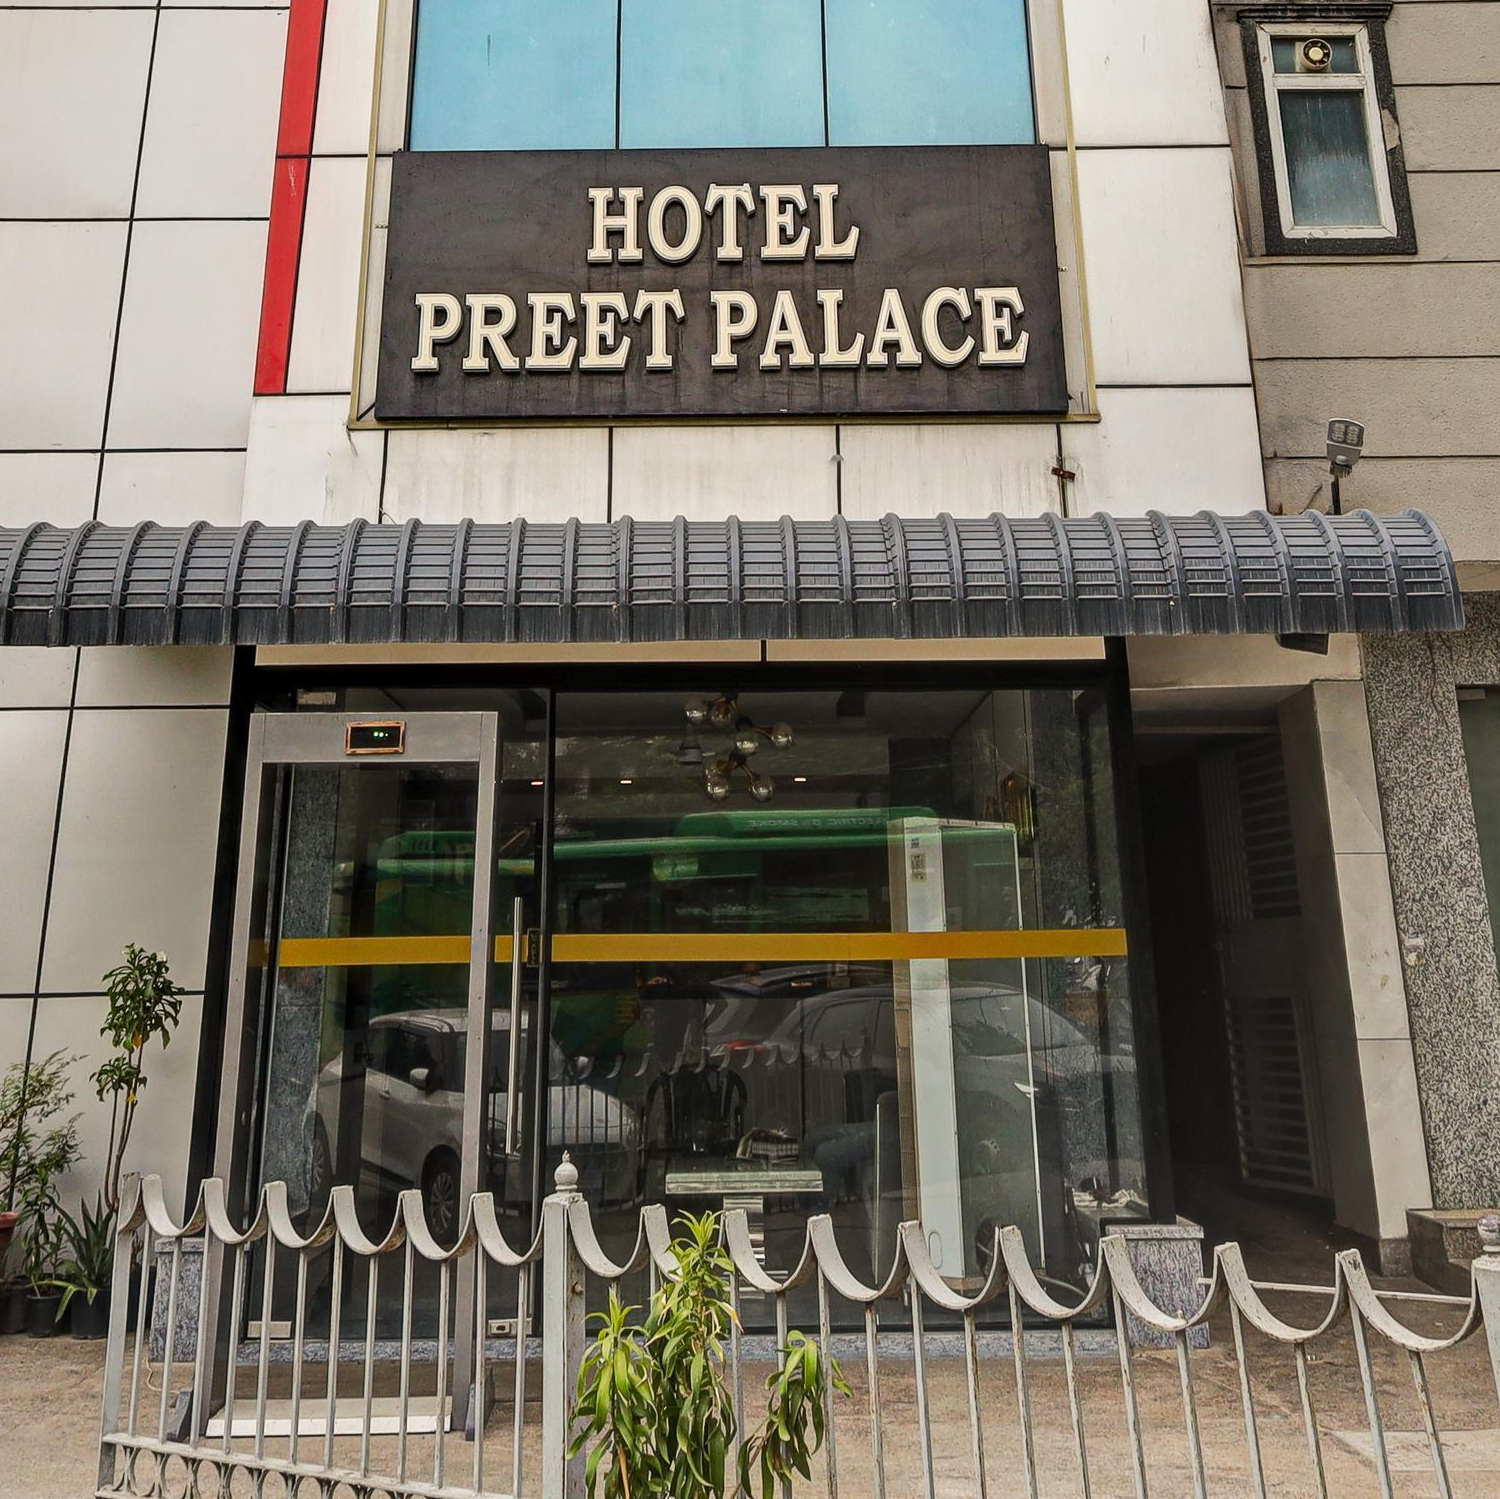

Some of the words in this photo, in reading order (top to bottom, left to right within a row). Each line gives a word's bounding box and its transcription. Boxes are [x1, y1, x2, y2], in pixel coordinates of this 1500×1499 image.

[586, 182, 860, 264] HOTEL
[411, 287, 685, 373] PREET
[708, 285, 1031, 371] PALACE
